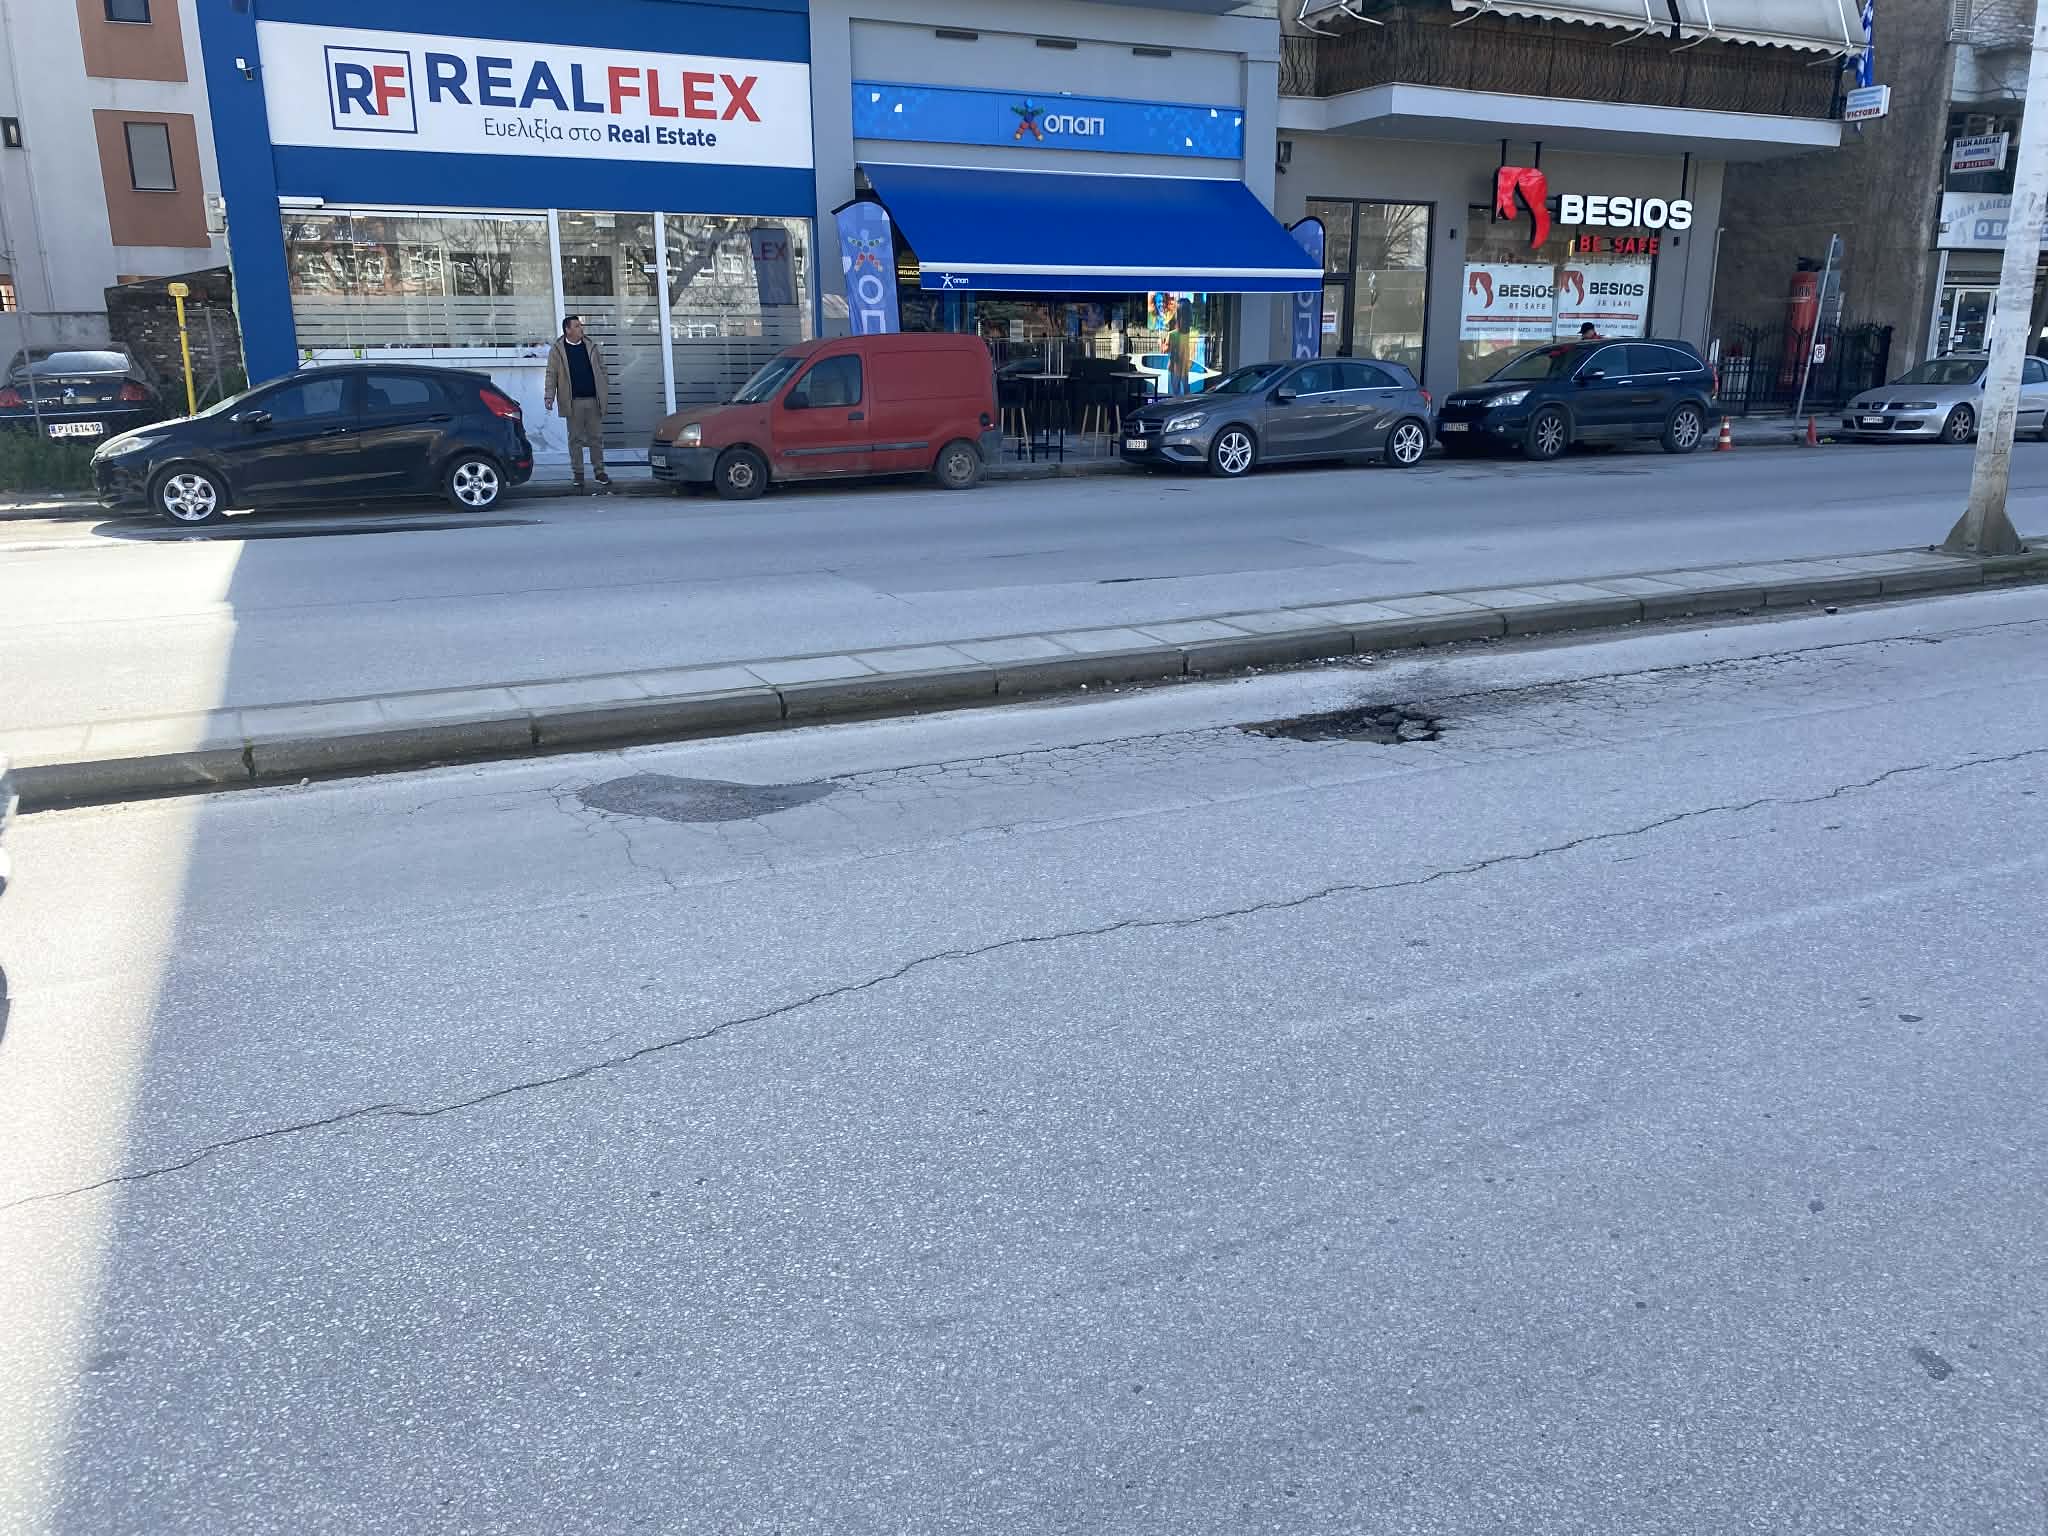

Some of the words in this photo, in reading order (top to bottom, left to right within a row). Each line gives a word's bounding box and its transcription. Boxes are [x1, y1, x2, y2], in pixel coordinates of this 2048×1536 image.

[335, 63, 406, 116] RF
[425, 52, 761, 122] REALFLEX
[484, 117, 563, 142] Ευελιξία
[569, 127, 602, 142] στο
[607, 124, 650, 144] Real
[656, 126, 717, 147] Estate
[1560, 194, 1693, 230] BESIOS
[1580, 235, 1601, 252] BE
[1615, 236, 1660, 255] SAFE
[1498, 284, 1553, 298] BESIOS
[1589, 282, 1644, 297] BESIOS
